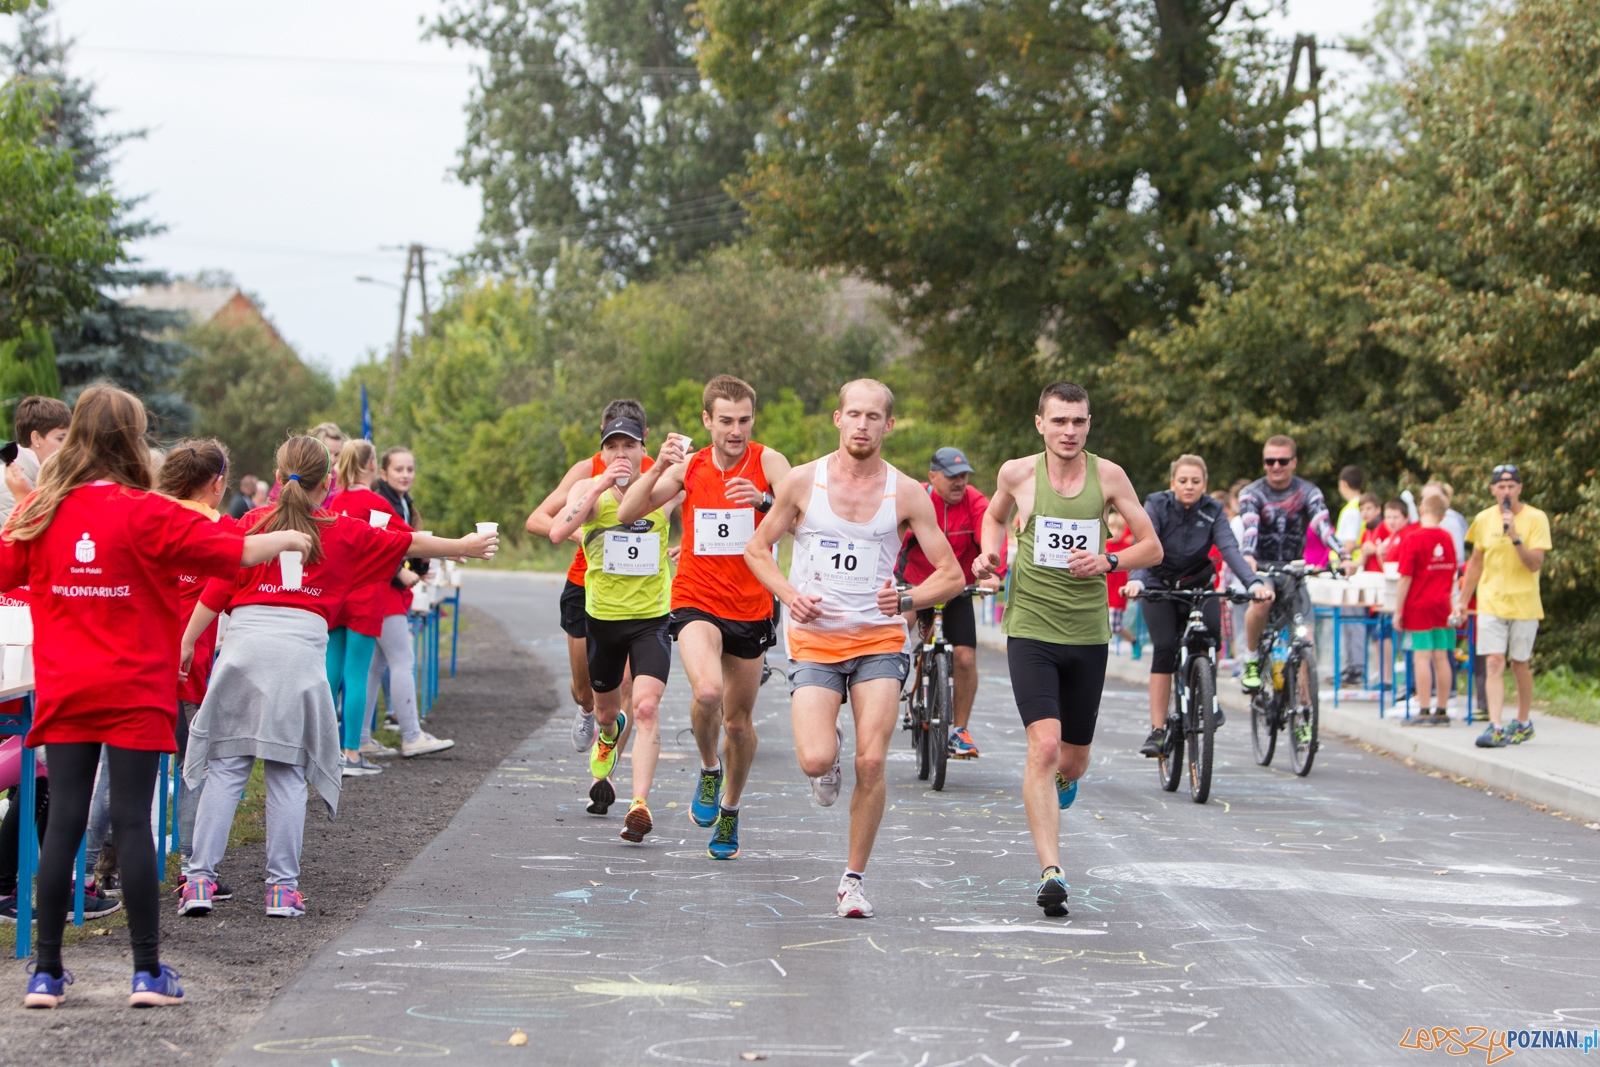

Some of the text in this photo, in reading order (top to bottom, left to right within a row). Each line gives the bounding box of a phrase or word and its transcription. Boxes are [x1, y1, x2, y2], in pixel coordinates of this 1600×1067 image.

[717, 523, 730, 538] 8
[1048, 533, 1087, 550] 392
[627, 545, 639, 560] 9
[831, 553, 857, 571] 10
[51, 585, 131, 598] WOLONTARIUSZ
